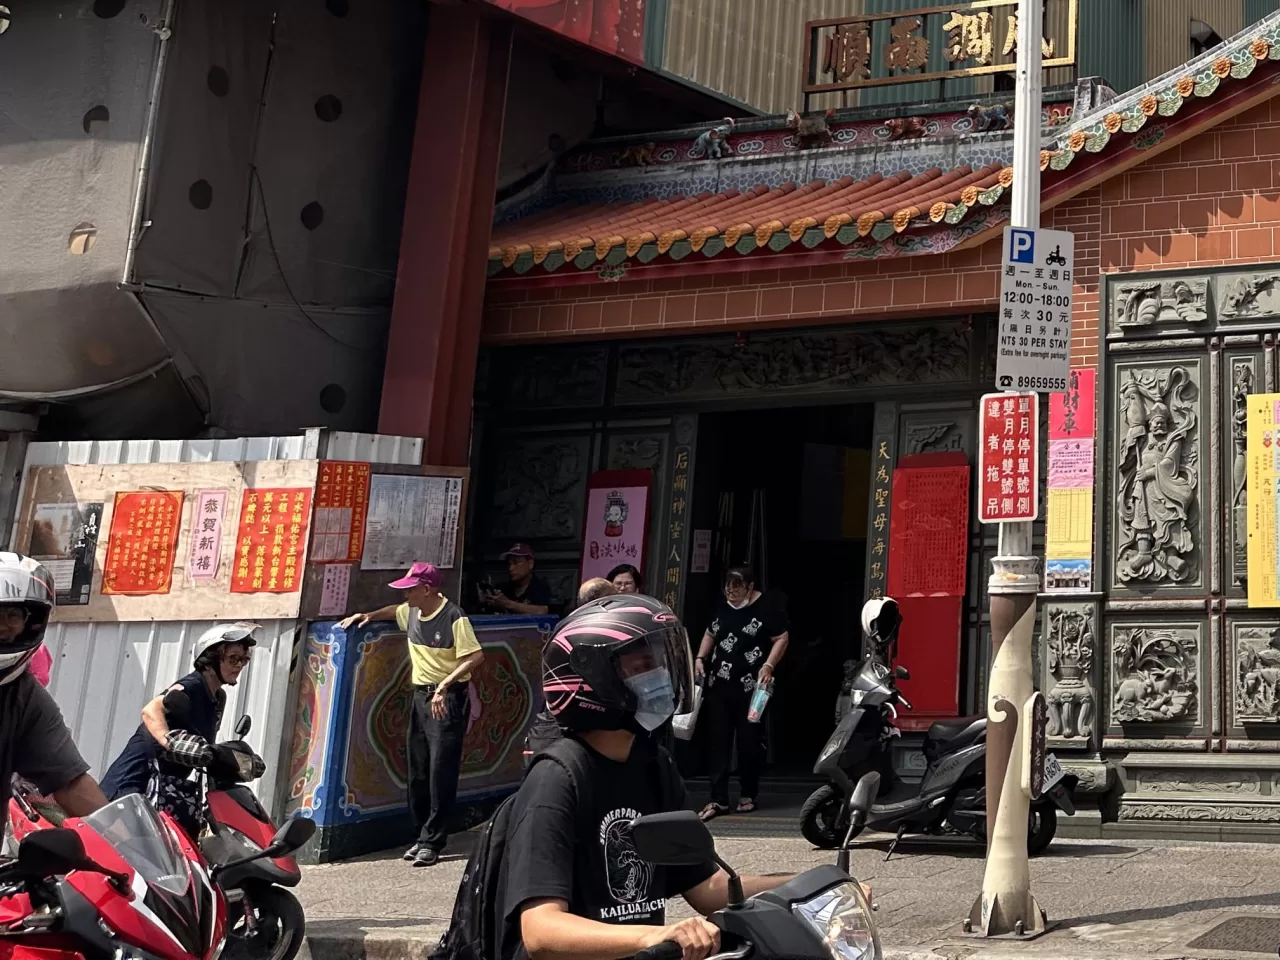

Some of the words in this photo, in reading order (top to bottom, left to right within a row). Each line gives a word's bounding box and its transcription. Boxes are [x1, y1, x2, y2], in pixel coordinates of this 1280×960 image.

[1012, 232, 1032, 260] P
[1005, 265, 1071, 281] 週一至週日
[1004, 292, 1070, 307] 12:00-18:00
[1003, 308, 1069, 323] 每次30元
[1001, 337, 1016, 346] NT$
[1019, 337, 1028, 347] 30
[1031, 338, 1046, 348] PER
[1050, 339, 1068, 349] STAY
[1017, 376, 1066, 390] 89659555
[987, 401, 1001, 517] 違者拖吊
[1001, 398, 1015, 514] 雙月停雙號側
[1016, 397, 1031, 514] 單月停單號側
[196, 498, 219, 571] 恭賀新禧
